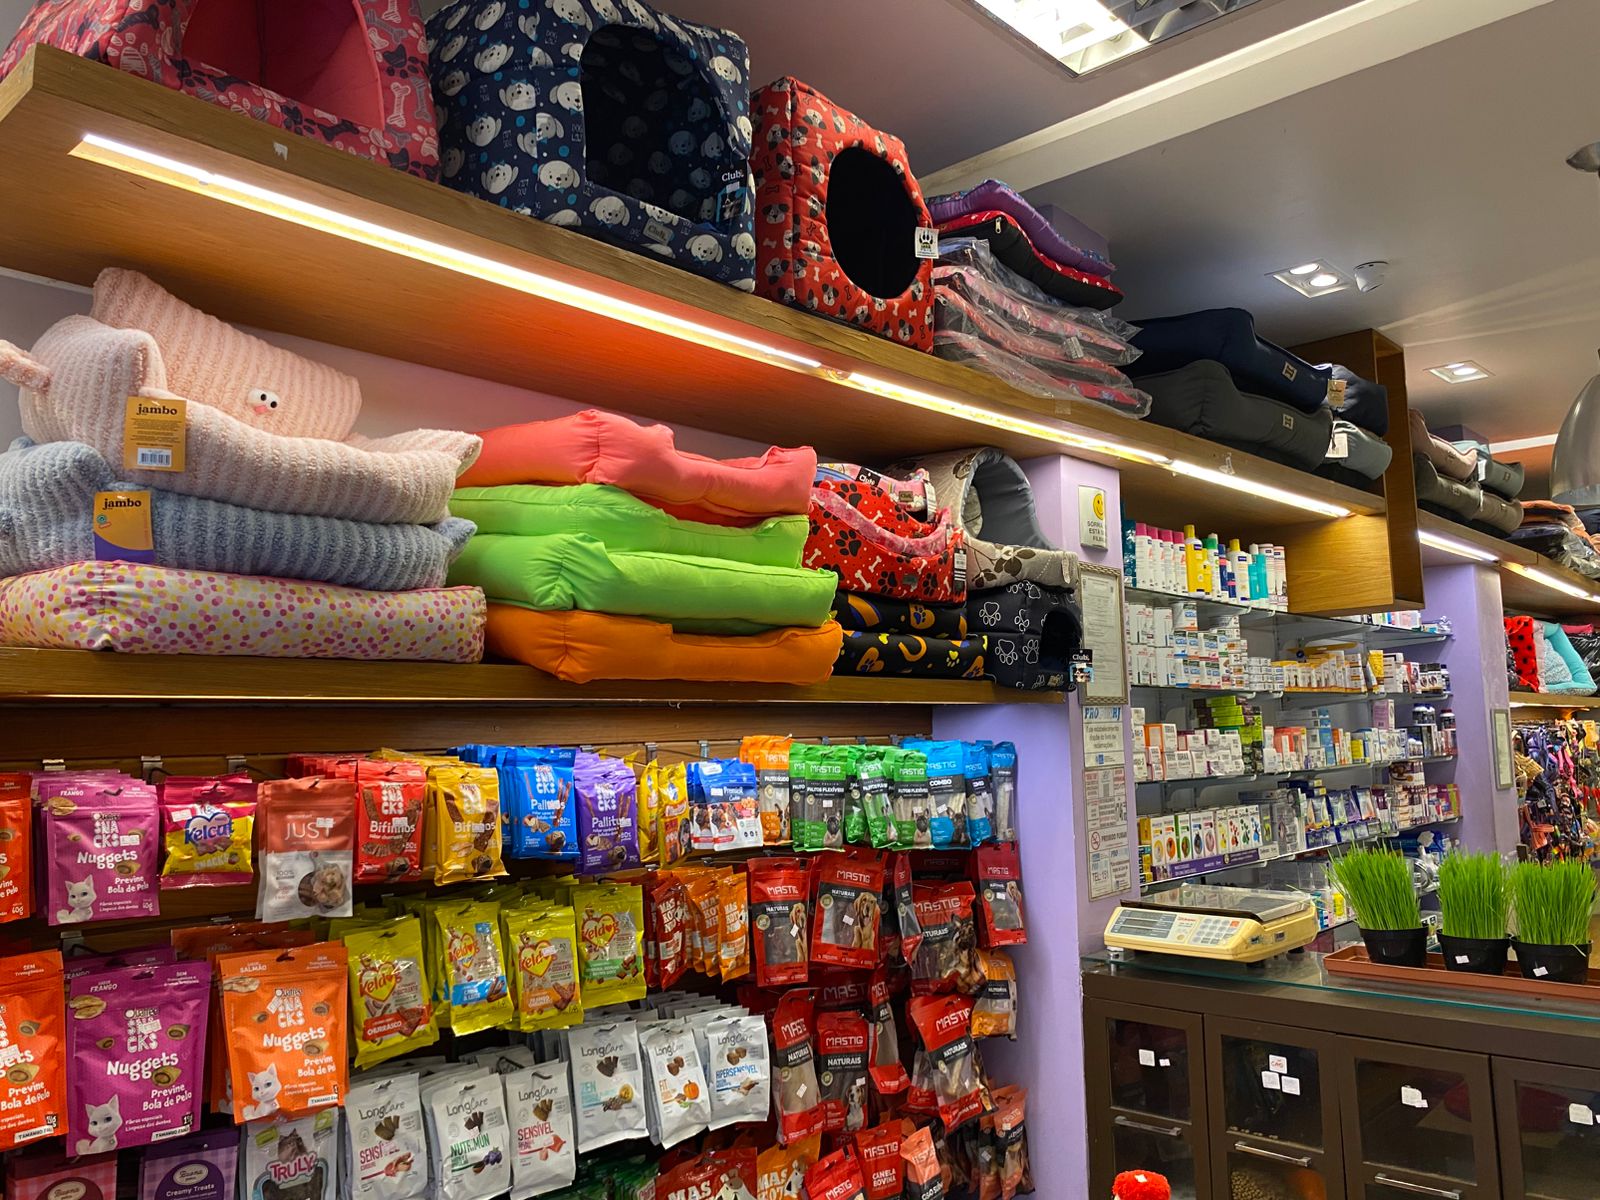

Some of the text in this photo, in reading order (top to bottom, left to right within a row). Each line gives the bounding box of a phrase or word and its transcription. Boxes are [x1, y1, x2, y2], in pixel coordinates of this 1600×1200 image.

[136, 404, 178, 415] jambo
[103, 498, 142, 510] jambo
[810, 765, 841, 774] MASTIG
[930, 779, 952, 787] COMBO
[185, 820, 235, 845] Kelcat
[285, 820, 336, 841] JUST
[77, 850, 138, 869] Nuggets
[115, 875, 144, 885] Previne
[837, 870, 871, 884] MASTIG
[107, 882, 149, 894] Bola de Pelo
[831, 888, 856, 897] NATURAIS
[913, 897, 961, 913] MASTIG
[90, 983, 118, 993] FRANGO
[278, 1010, 305, 1028] CKS
[127, 1033, 158, 1053] CKS
[263, 1027, 326, 1052] Nuggets
[826, 1036, 863, 1046] MASTIG
[581, 1043, 624, 1057] LongCare
[107, 1052, 179, 1081] Nuggets
[828, 1057, 861, 1066] NATURAIS
[297, 1066, 315, 1078] Bola
[8, 1082, 45, 1097] Previne
[151, 1083, 185, 1099] Previne
[518, 1085, 559, 1102] LongCare
[0, 1098, 22, 1111] Bola
[24, 1095, 36, 1105] de
[142, 1090, 192, 1111] Bola de Pelo
[447, 1097, 489, 1117] LongCare
[359, 1101, 405, 1120] LongCare
[517, 1121, 554, 1141] SENSÍVEL
[360, 1143, 385, 1164] SENSÍ
[864, 1142, 898, 1159] MASTIG
[270, 1154, 316, 1181] TRULY
[872, 1168, 896, 1180] CANELA
[826, 1180, 852, 1199] MASTIG
[873, 1176, 896, 1187] BOVINA
[166, 1184, 215, 1198] Creamy Treats
